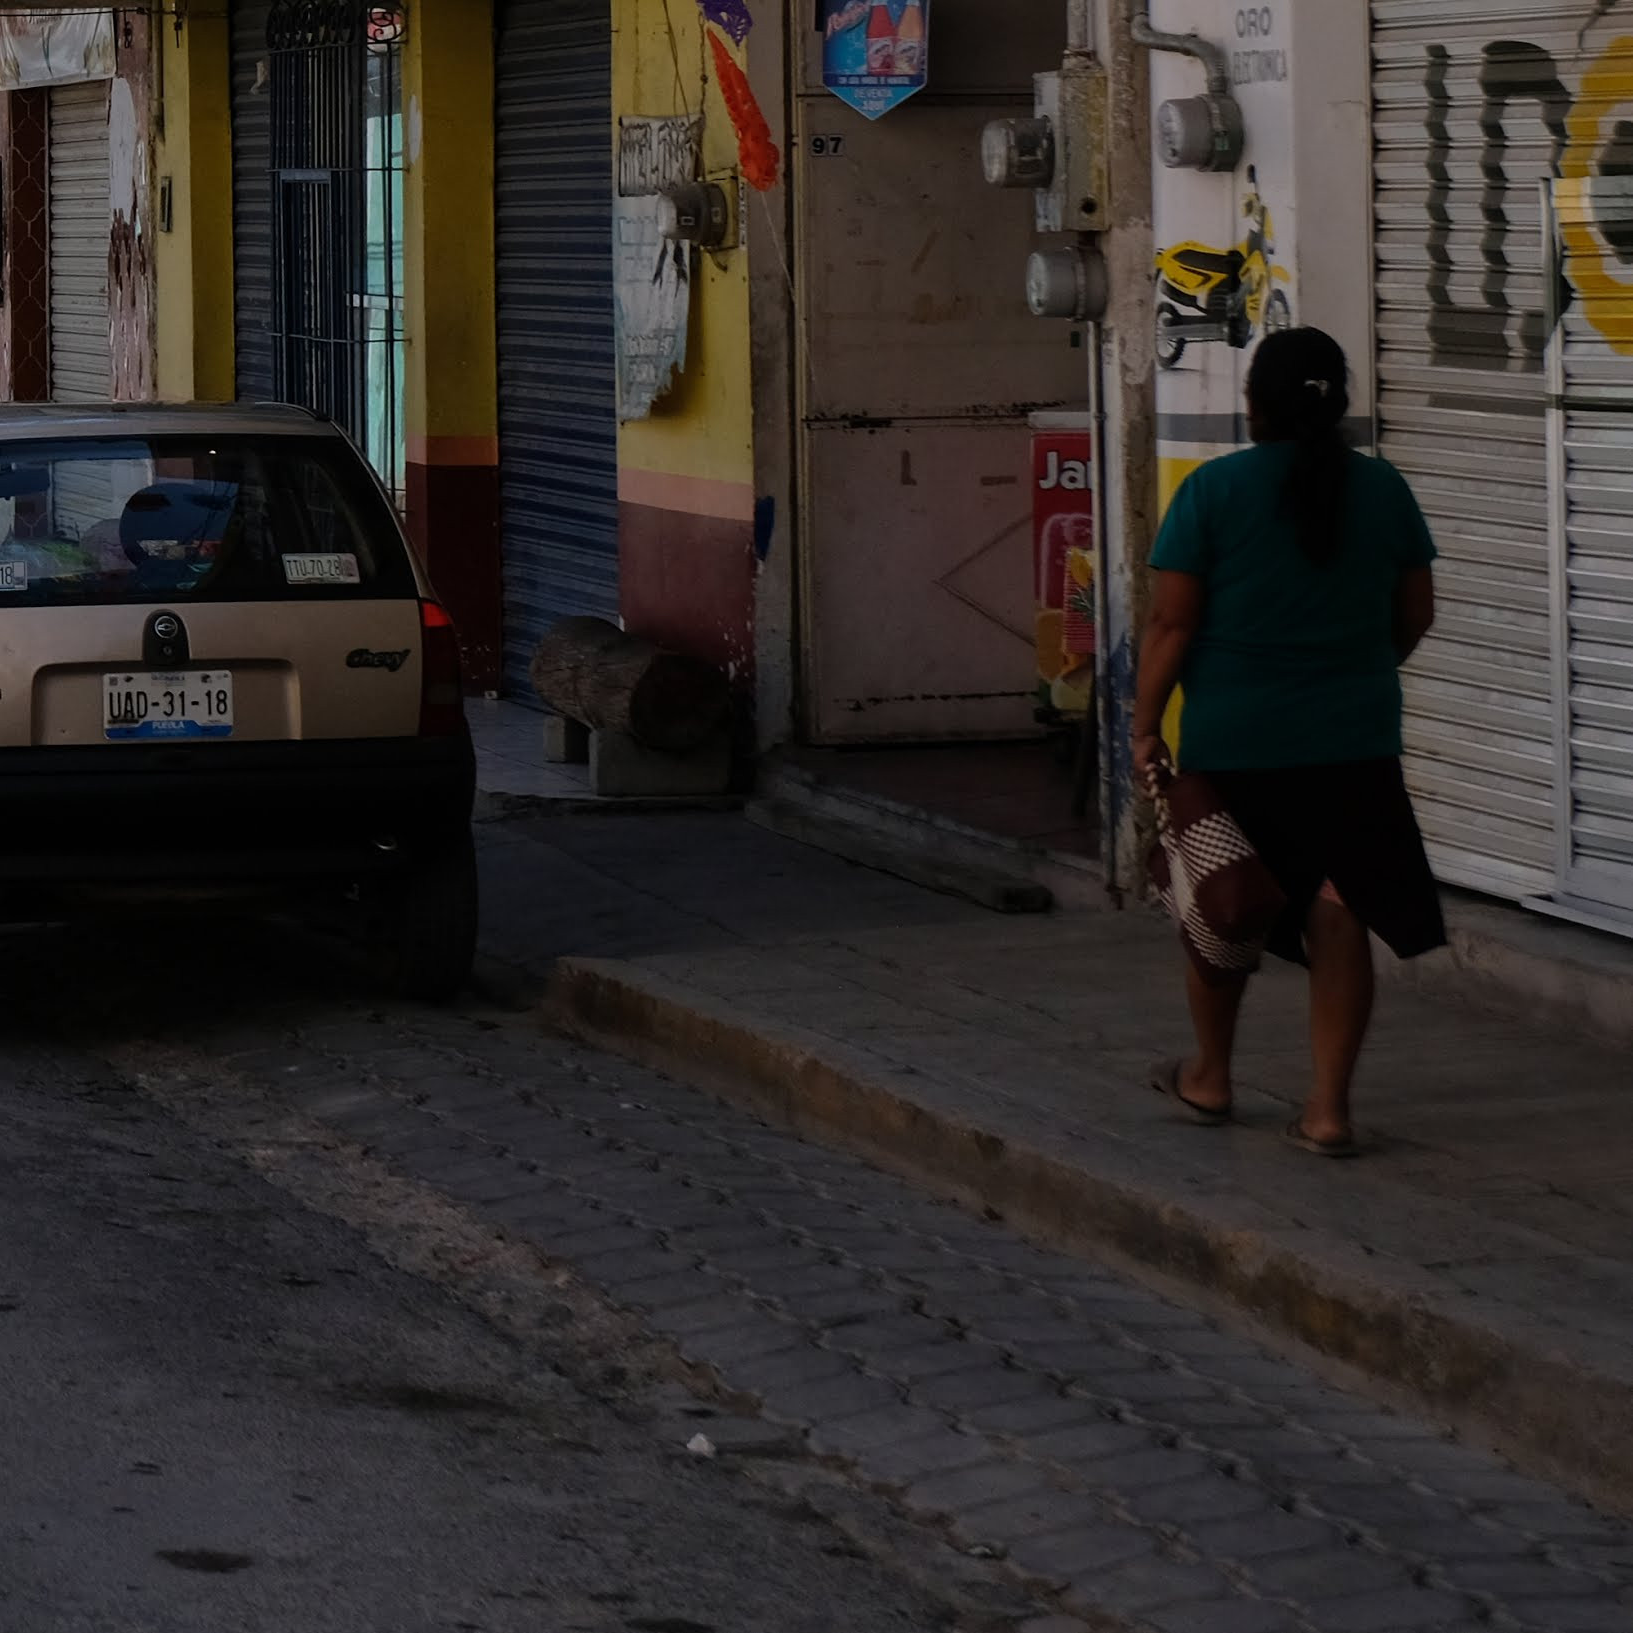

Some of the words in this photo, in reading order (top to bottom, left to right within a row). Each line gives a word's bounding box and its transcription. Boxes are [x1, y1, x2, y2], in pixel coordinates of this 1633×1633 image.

[1236, 6, 1271, 38] ORO
[812, 137, 842, 155] 97
[346, 648, 412, 673] Chevy
[108, 689, 228, 719] UAD-31-18
